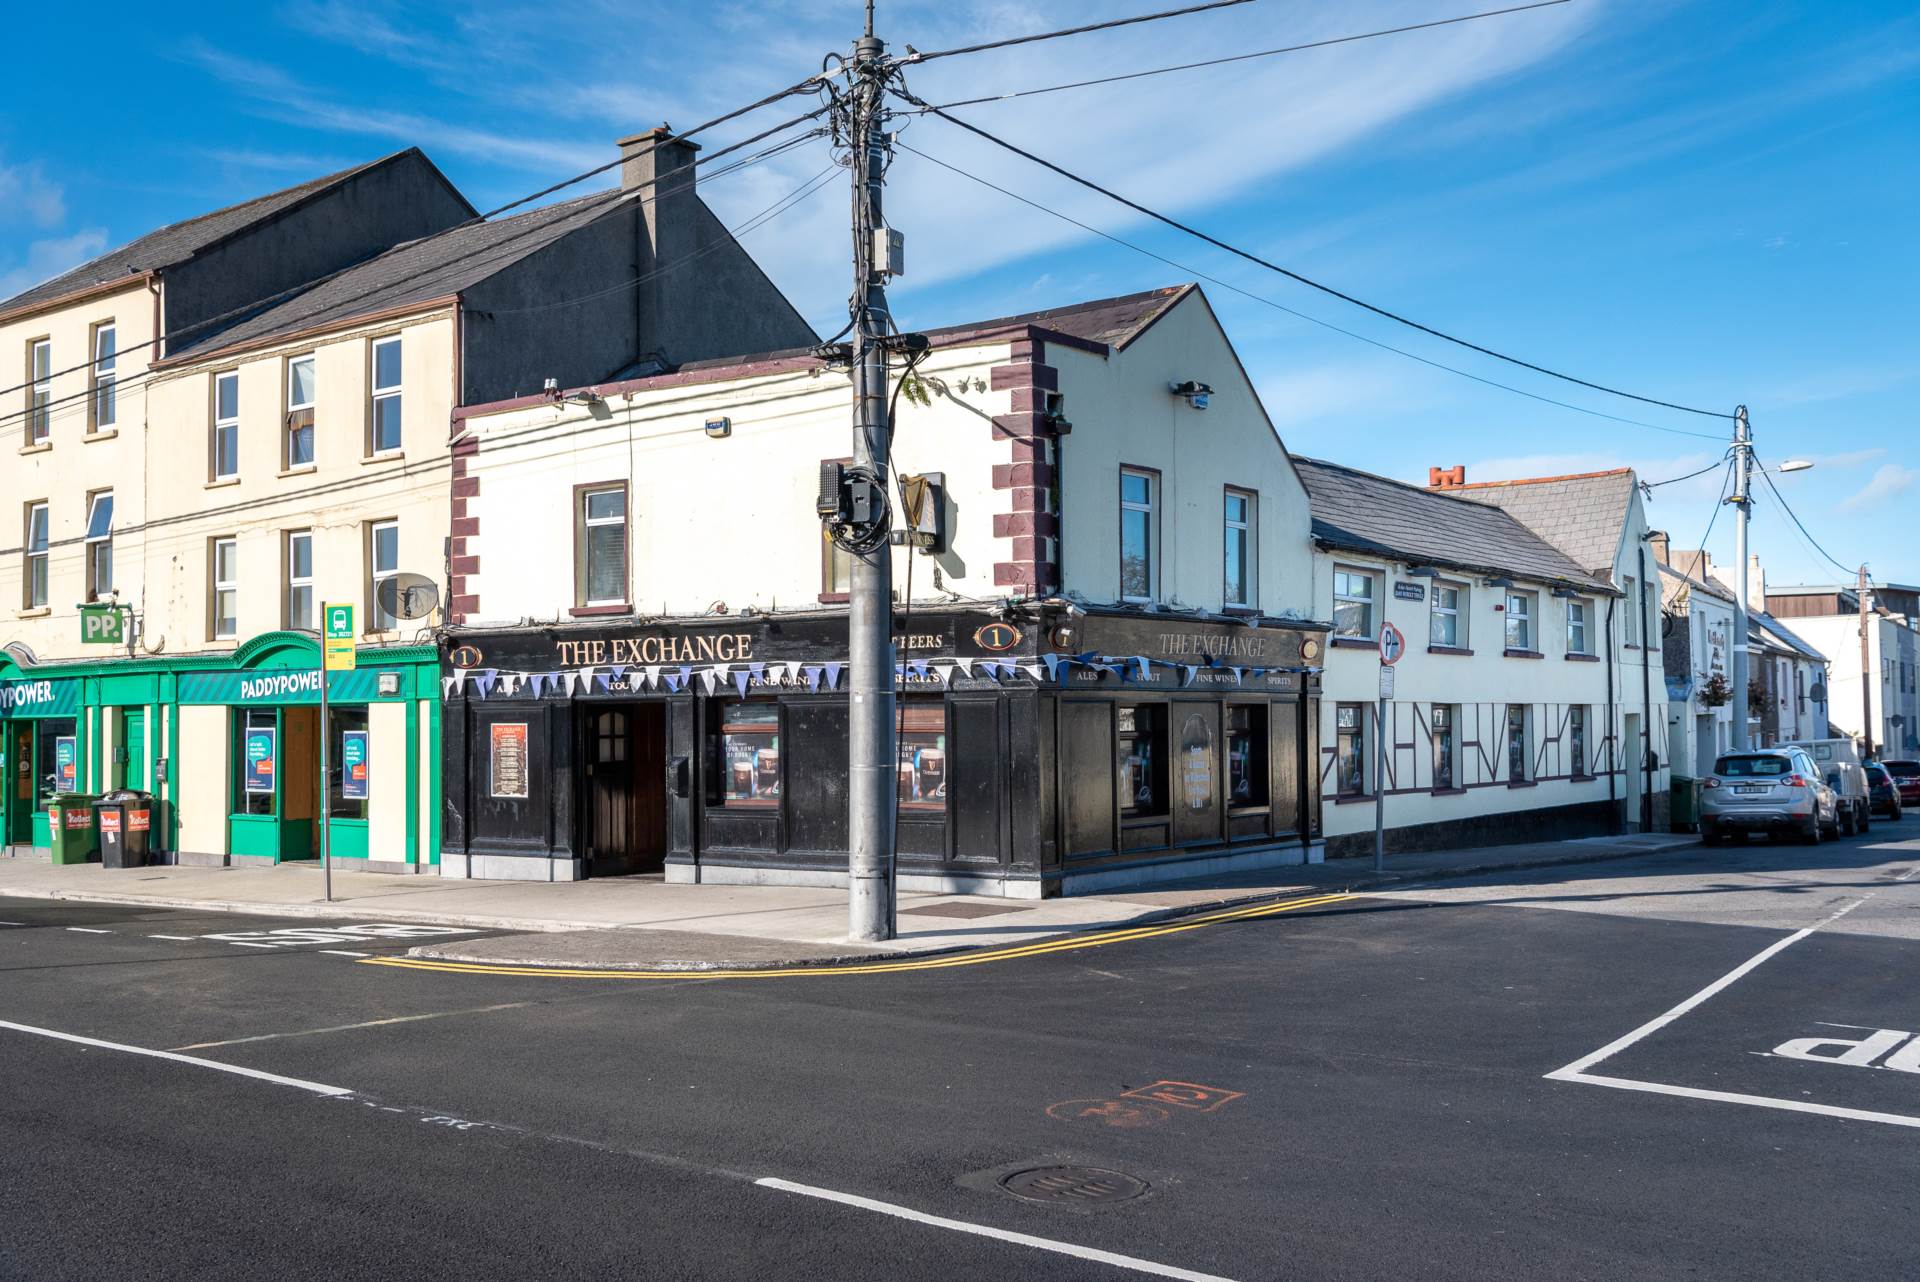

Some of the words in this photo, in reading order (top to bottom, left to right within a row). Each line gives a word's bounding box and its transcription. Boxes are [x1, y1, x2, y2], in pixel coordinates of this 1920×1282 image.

[86, 615, 120, 639] PP.
[991, 627, 1002, 647] 1
[556, 640, 607, 666] THE
[612, 634, 753, 664] EXCHANGE
[1160, 633, 1189, 655] THE
[1193, 634, 1266, 657] EXCHANGE
[460, 651, 468, 666] 1
[1077, 671, 1098, 681] ALES
[1136, 672, 1161, 681] STUT
[1196, 674, 1213, 683] FINE
[1267, 676, 1292, 686] SPIRITS
[200, 923, 485, 945] BUS
